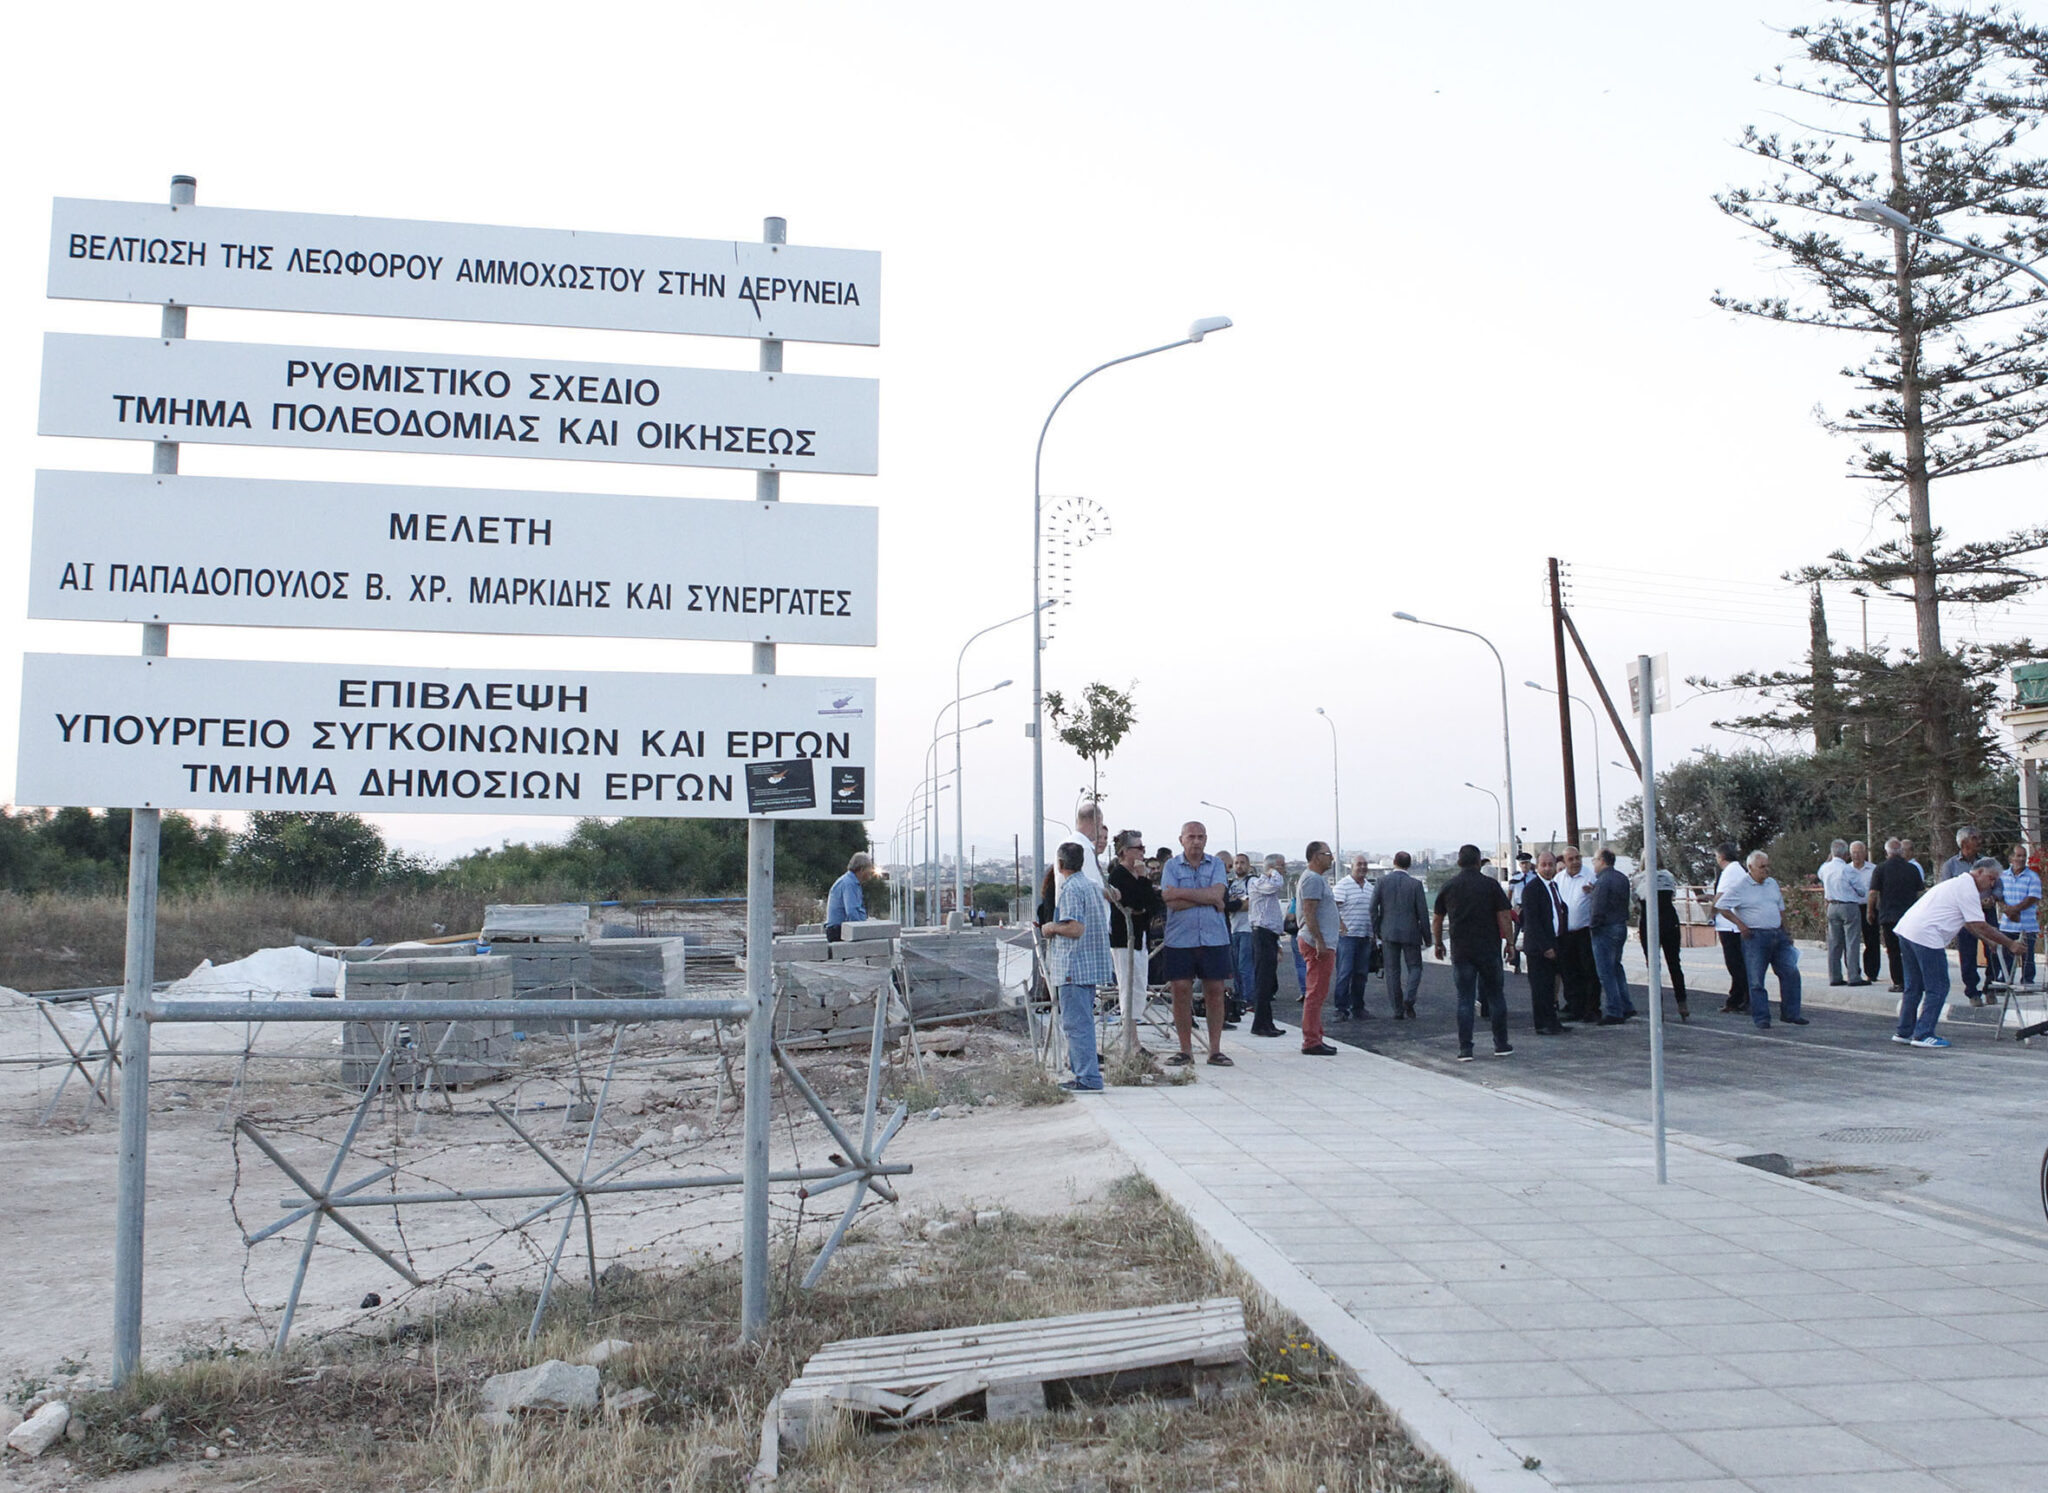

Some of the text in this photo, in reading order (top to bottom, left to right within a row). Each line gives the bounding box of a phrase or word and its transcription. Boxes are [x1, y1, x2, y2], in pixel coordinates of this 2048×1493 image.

[69, 233, 860, 307] ΒΕΛΤΙΩΣΗ ΤΗΣ ΛΕΩΦΟΡΟΥ ΑΜΜΟΧΩΣΤΟΥ ΣΤΗΝ ΔΕΡΥΝΕΙΑ
[286, 359, 660, 407] ΡΥΘΜΙΣΤΙΚΟ ΣΧΕΔΙΟ
[112, 394, 816, 457] ΤΜΗΜΑ ΠΟΛΕΟΔΟΜΙΑΣ ΚΑΙ ΟΙΚΗΣΕΩΣ
[389, 512, 552, 546] ΜΕΛΕΤΗ
[109, 563, 350, 600] ΠΑΠΑΔΟΠΟΥΛΟΣ
[365, 573, 391, 601] Β.
[409, 574, 452, 603] ΧΡ.
[469, 576, 611, 609] ΜΑΡΚΙΔΗΣ
[627, 582, 672, 611] ΚΑΙ
[687, 584, 852, 617] ΣΥΝΕΡΓΑΤΕΣ
[338, 679, 588, 713] ΕΠΙΒΛΕΨΗ
[55, 713, 850, 759] ΥΠΟΥΡΓΕΙΟ ΣΥΓΚΟΙΝΩΝΙΩΝ ΚΑΙ ΕΡΓΩΝ
[182, 763, 733, 802] ΤΜΗΜΑ ΔΗΜΟΣΙΩΝ ΕΡΓΩΝ
